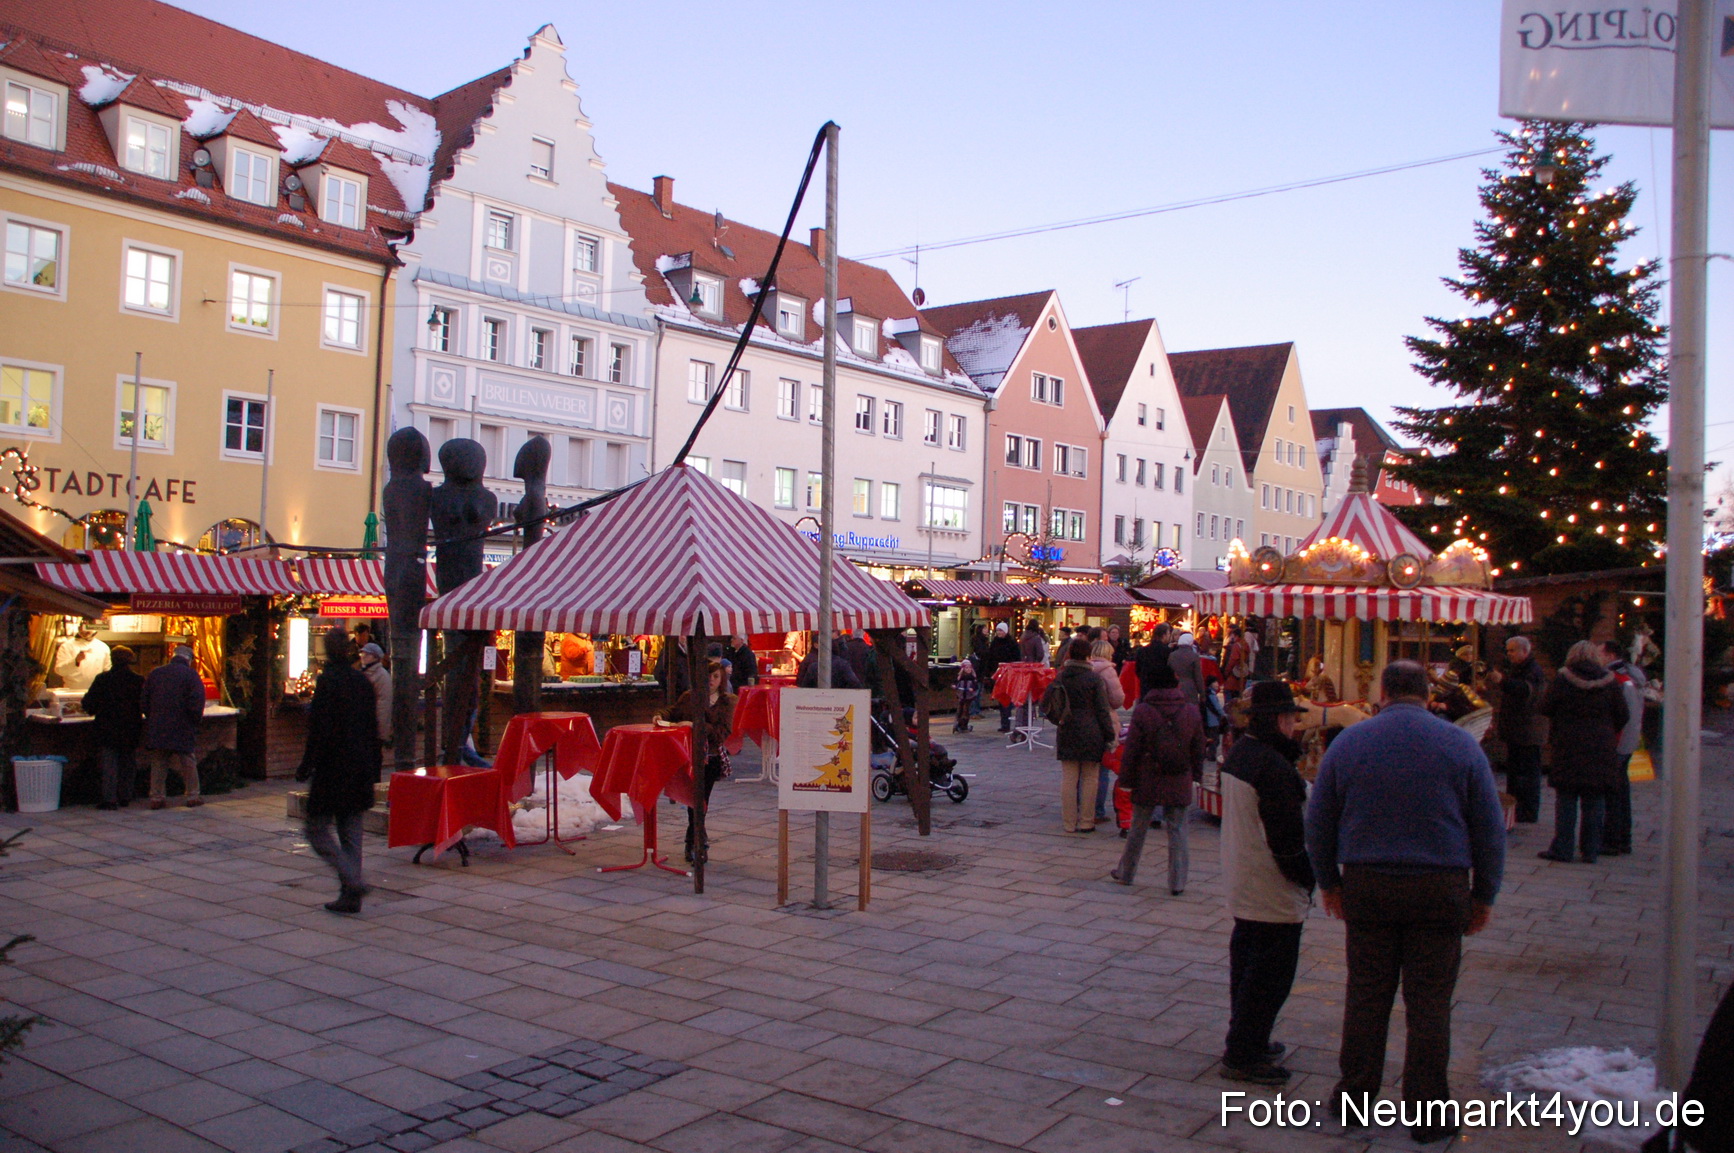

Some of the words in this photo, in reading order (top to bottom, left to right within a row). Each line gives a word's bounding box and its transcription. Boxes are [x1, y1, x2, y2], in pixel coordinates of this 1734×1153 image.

[484, 383, 539, 409] BRILLEN
[540, 392, 587, 416] WEBER
[848, 531, 899, 550] Rupprecht
[136, 600, 181, 609] PIZZERIA
[324, 606, 357, 614] HEISSER
